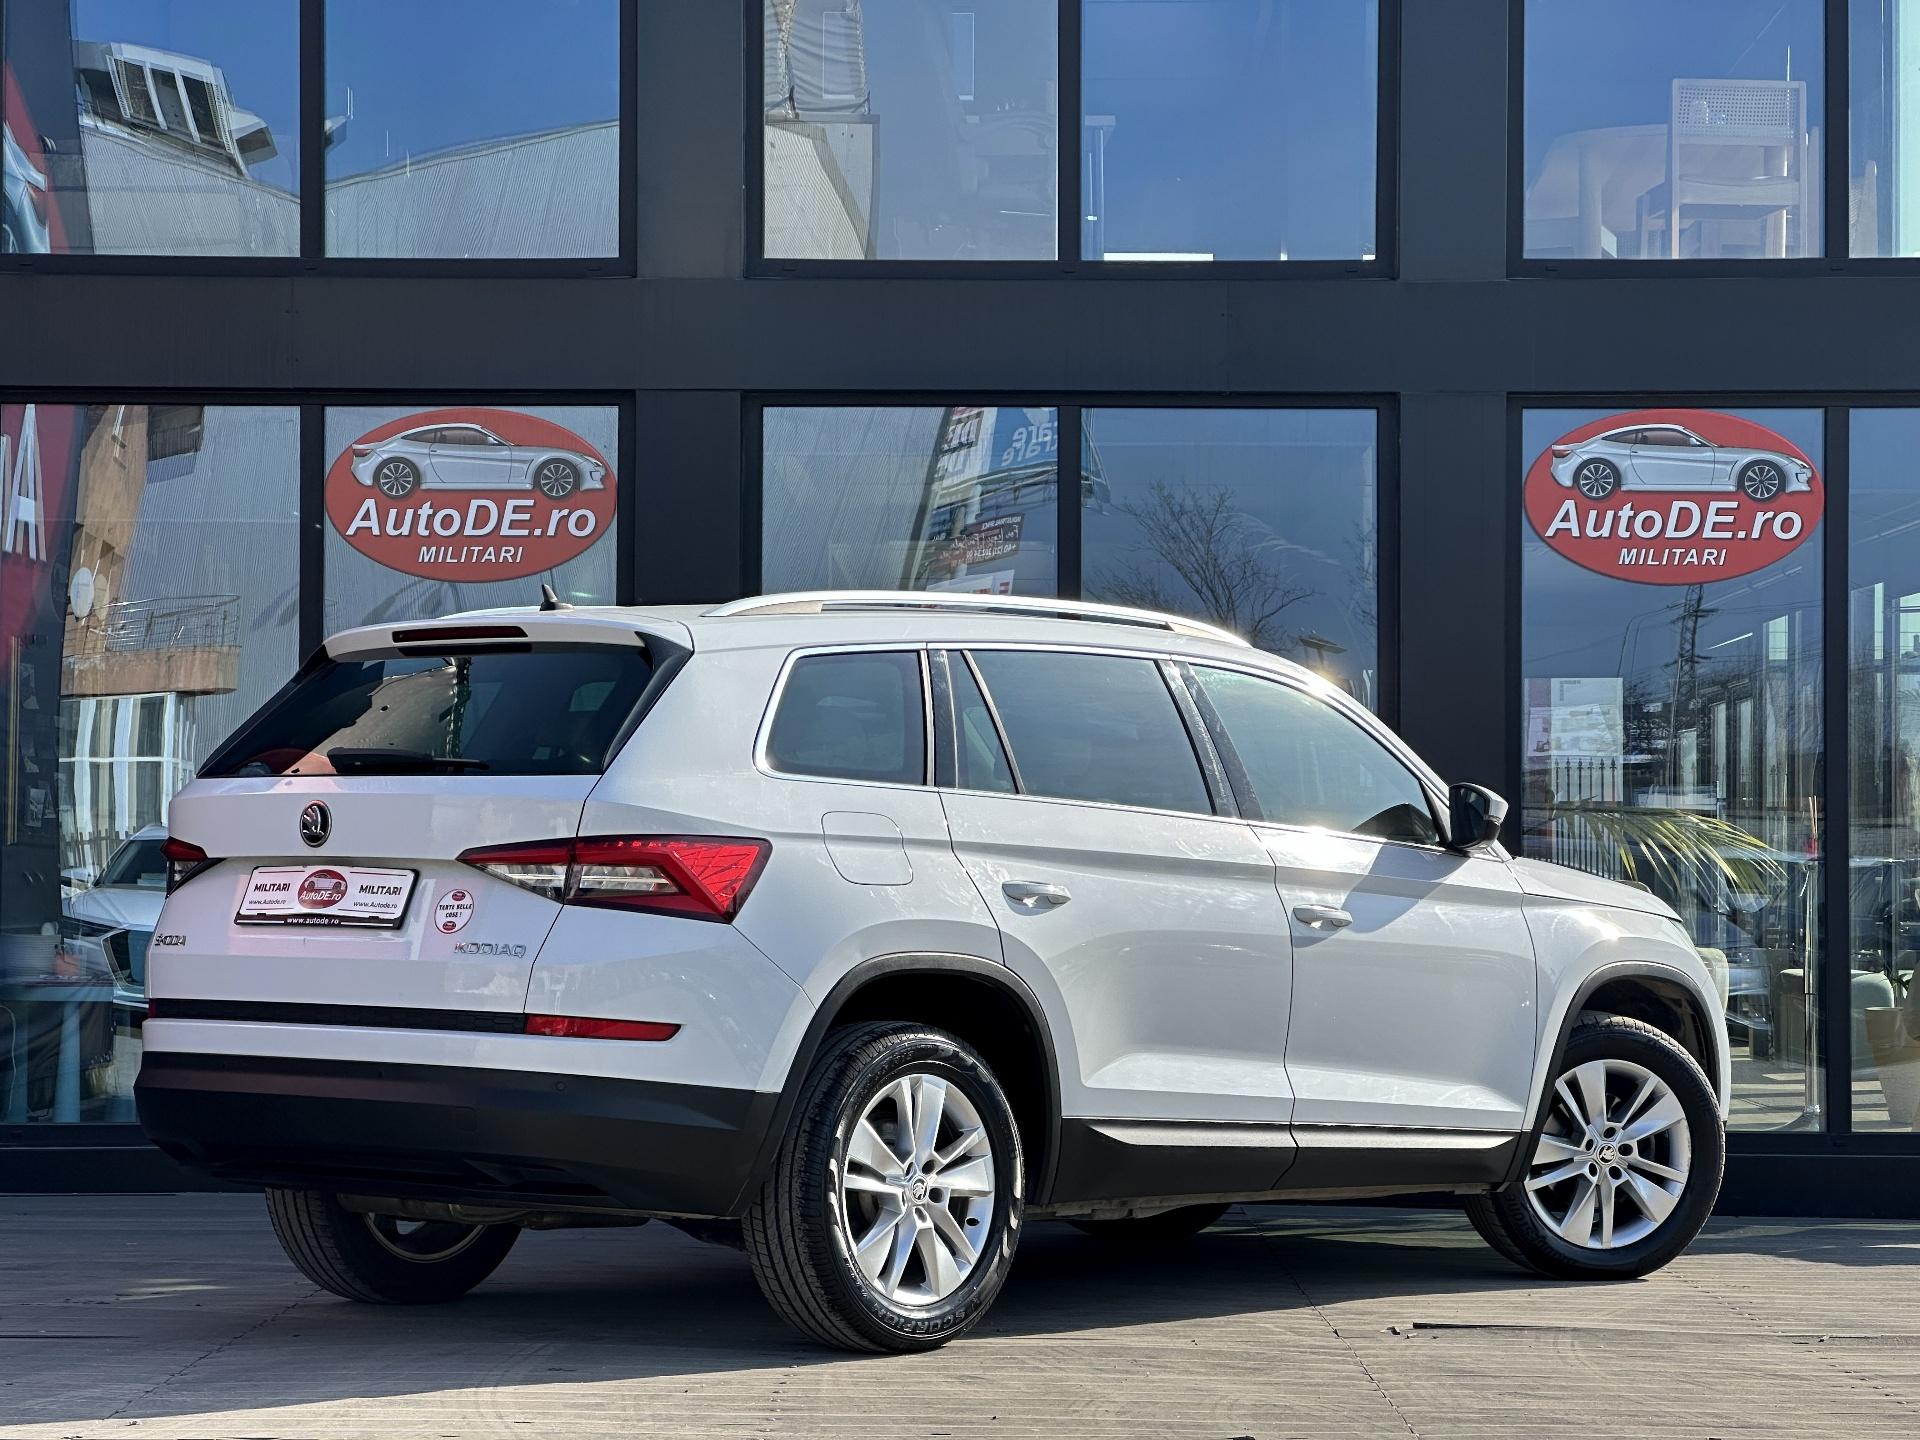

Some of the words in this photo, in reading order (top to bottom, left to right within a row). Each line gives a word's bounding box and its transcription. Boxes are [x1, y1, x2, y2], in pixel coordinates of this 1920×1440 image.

[345, 498, 597, 537] AutoDE.ro
[1544, 499, 1802, 540] AutoDE.ro
[417, 546, 524, 563] MILITARI
[1618, 548, 1728, 566] MILITARI
[253, 882, 291, 892] MILITARI
[358, 884, 403, 896] MILITARI
[299, 890, 342, 901] AutoDE.ro
[286, 917, 340, 925] www.autode.ro
[453, 942, 527, 958] KODIAQ
